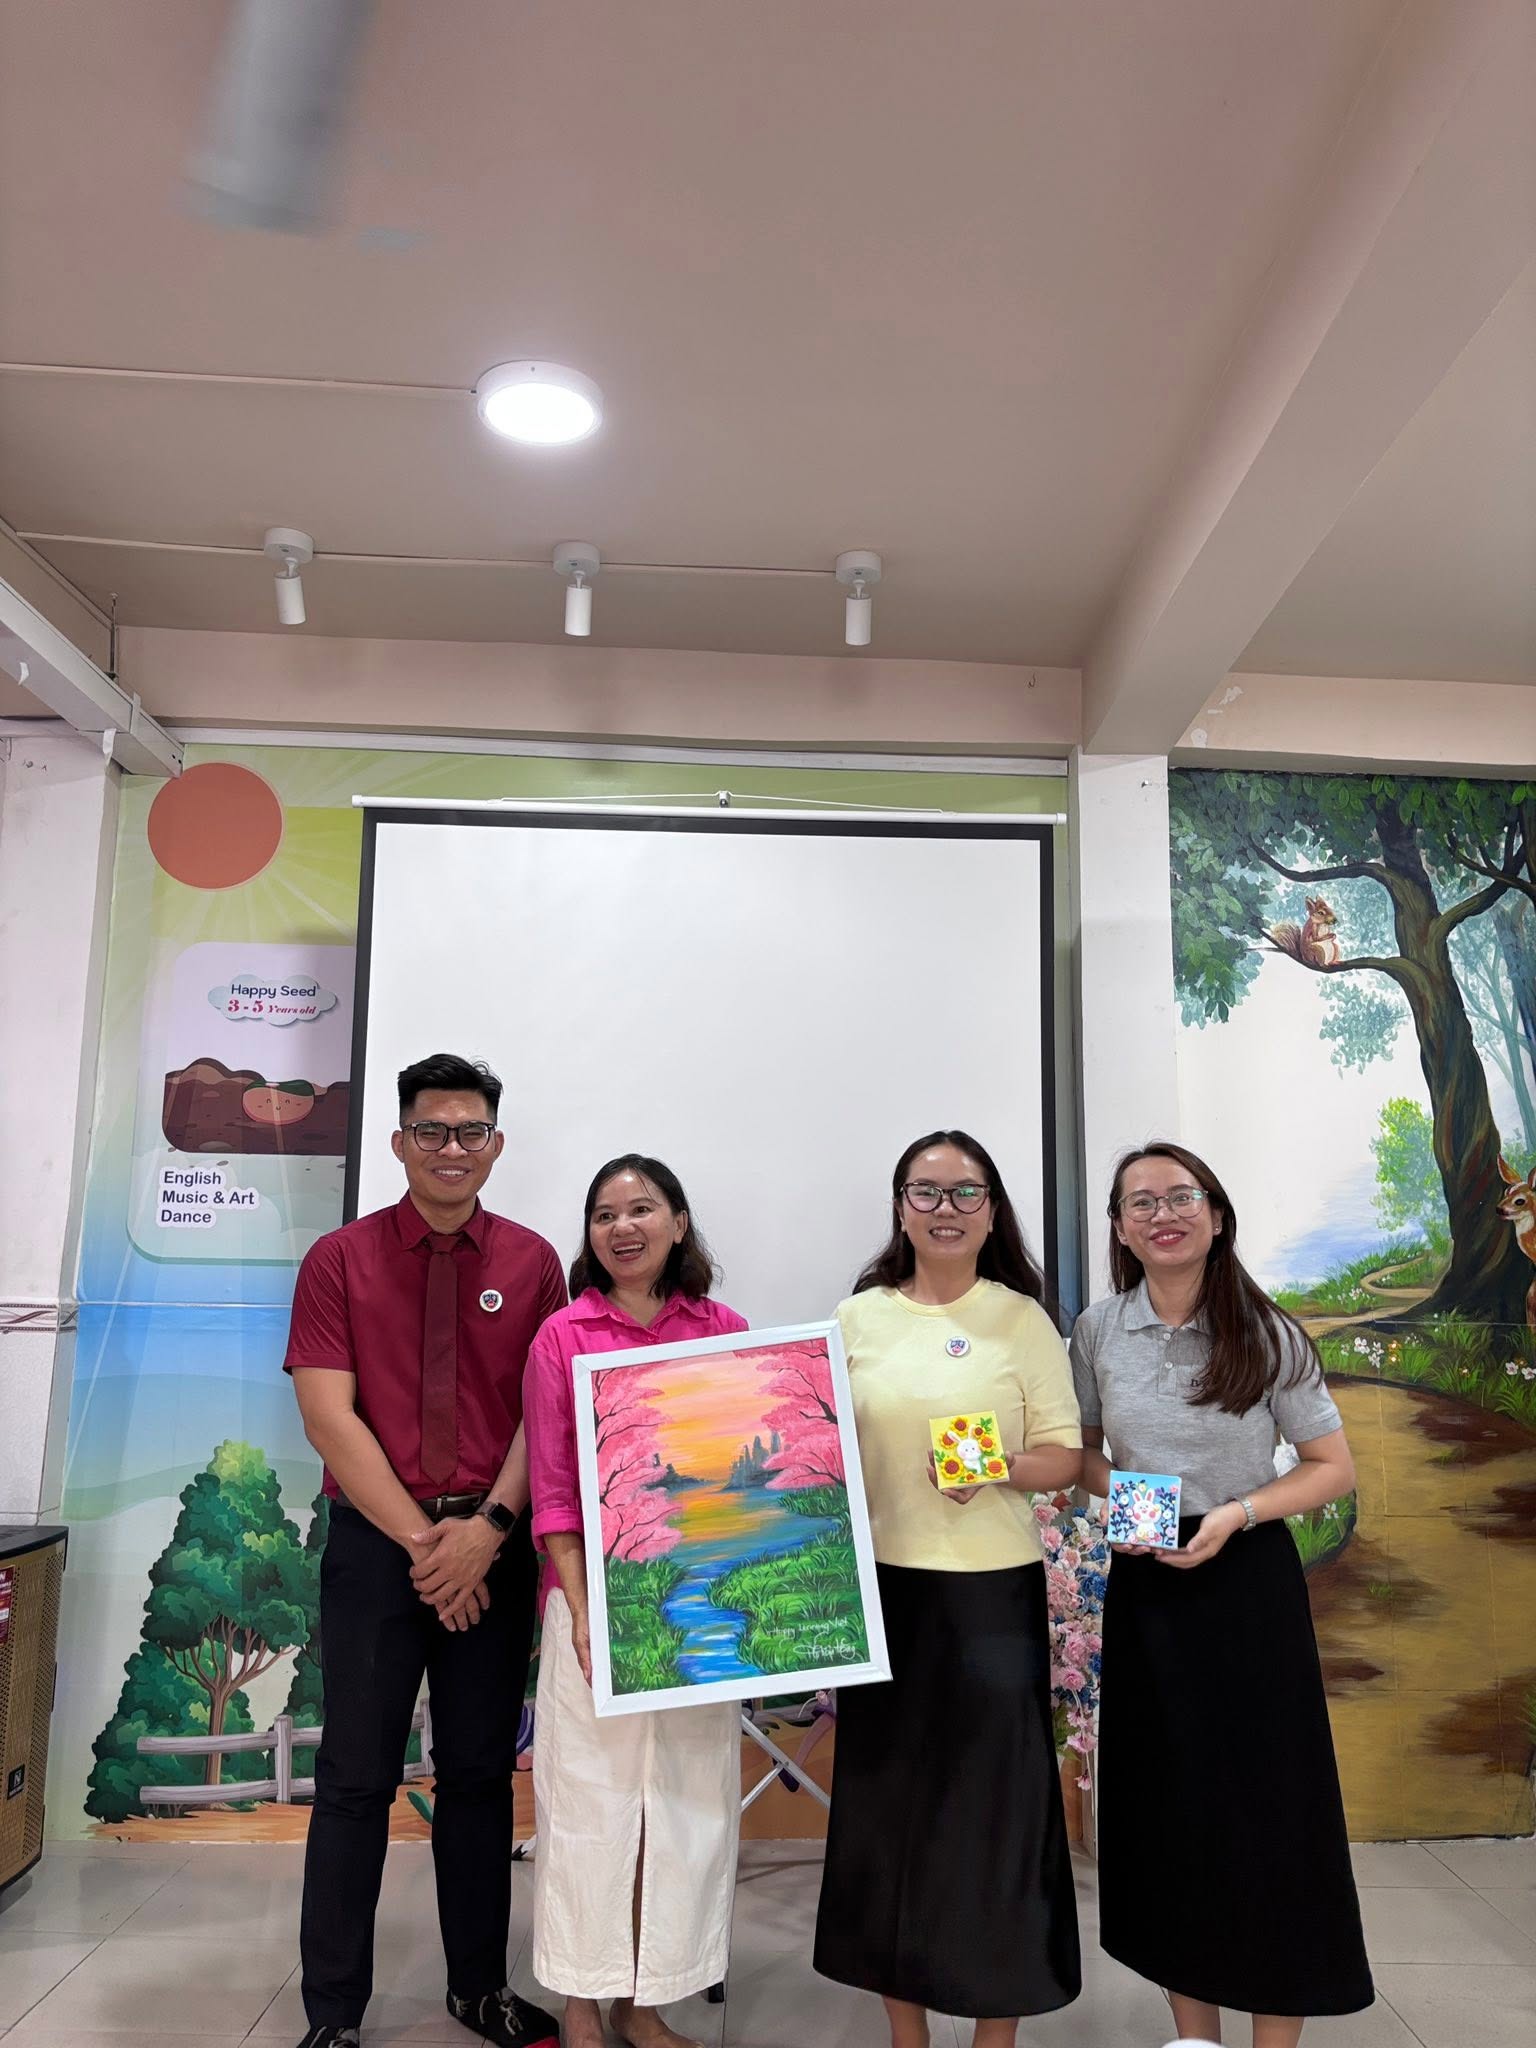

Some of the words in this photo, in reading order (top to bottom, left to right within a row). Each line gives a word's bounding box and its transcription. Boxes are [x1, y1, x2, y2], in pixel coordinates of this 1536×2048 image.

[231, 984, 276, 999] Happy
[280, 985, 316, 997] Seed
[228, 999, 240, 1013] 3
[252, 999, 264, 1013] 5
[268, 1005, 297, 1014] Years
[299, 1005, 317, 1015] old
[164, 1171, 221, 1187] English
[162, 1190, 208, 1204] Music
[213, 1191, 225, 1204] &
[229, 1191, 255, 1205] Art
[161, 1209, 212, 1223] Dance
